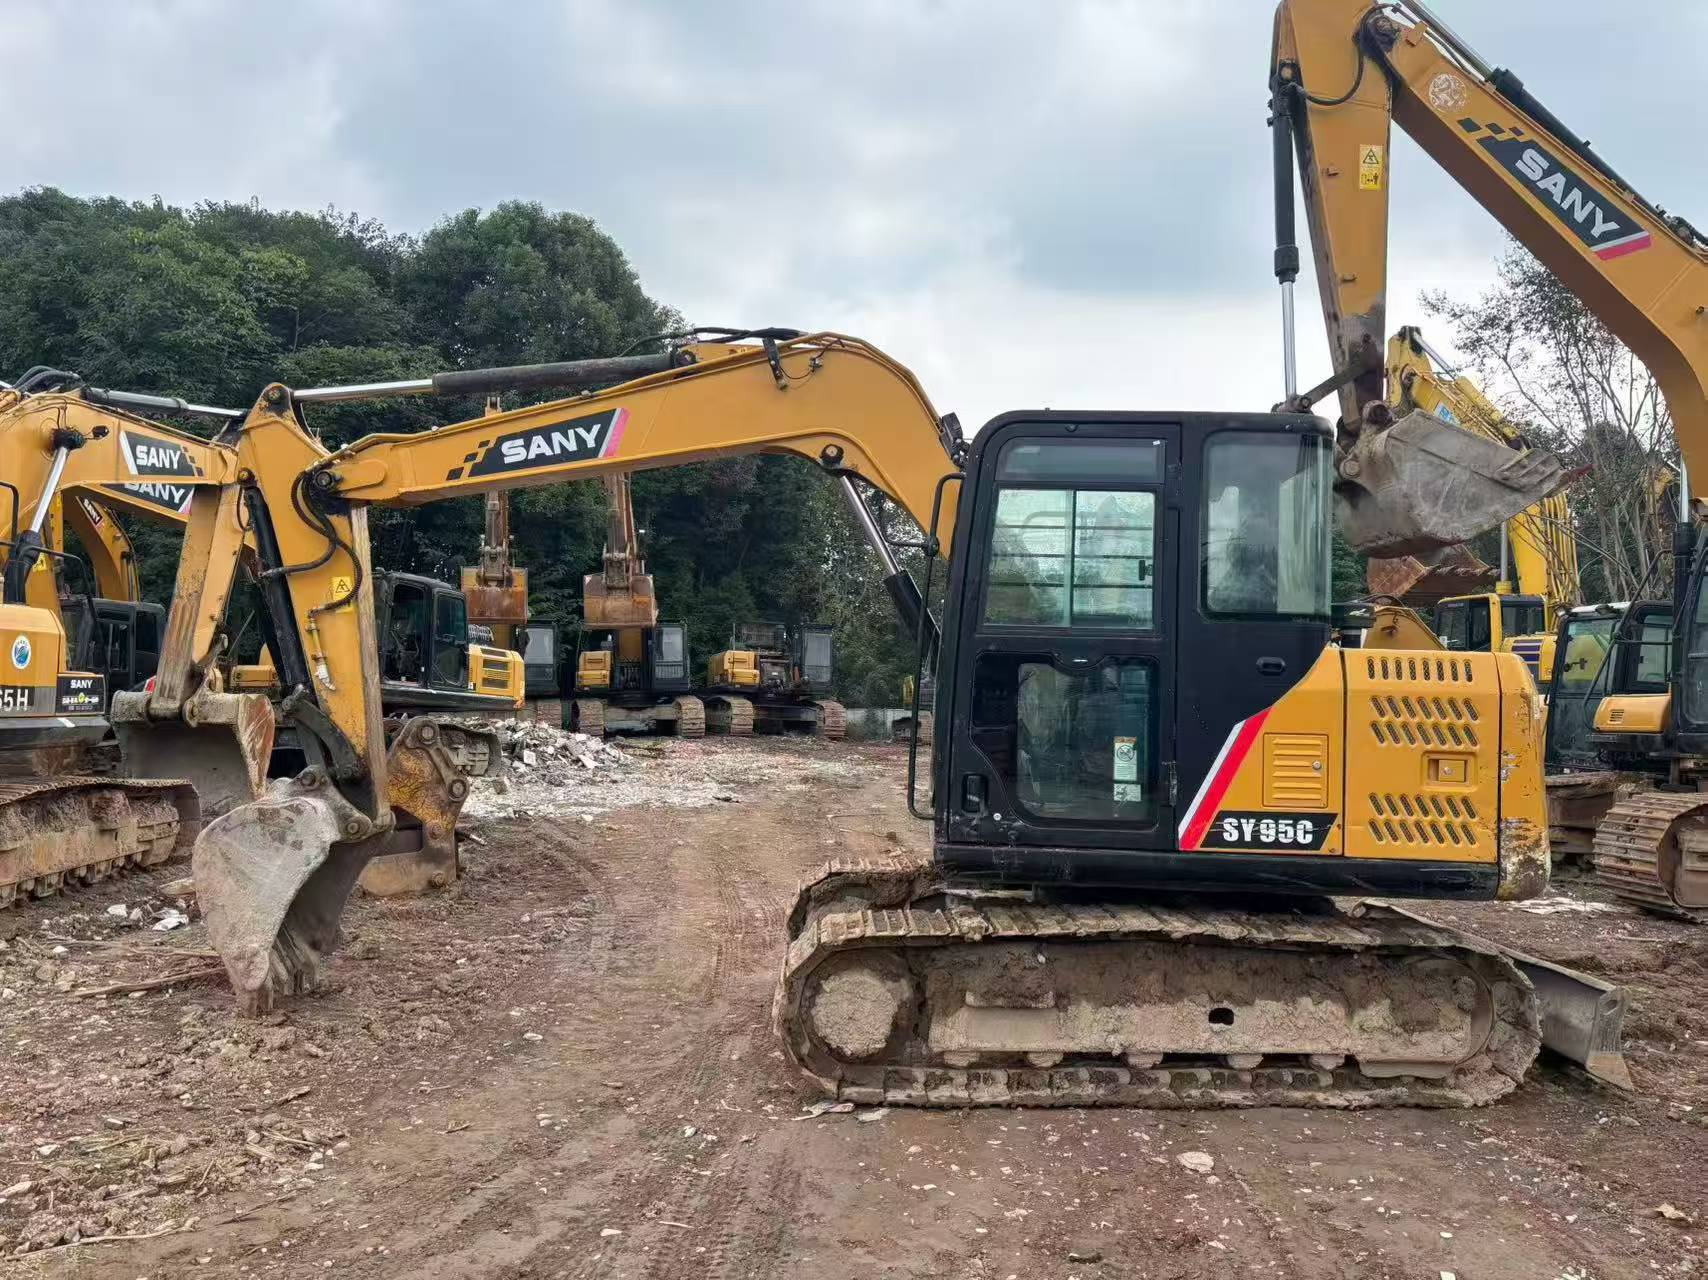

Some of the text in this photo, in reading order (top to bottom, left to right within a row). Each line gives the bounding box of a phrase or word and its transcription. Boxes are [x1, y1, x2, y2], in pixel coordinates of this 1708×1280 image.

[1515, 148, 1620, 238] SANY
[501, 423, 601, 464] SANY
[135, 445, 181, 470] SANY
[70, 679, 93, 689] SANY
[0, 688, 29, 712] 5H
[1222, 817, 1314, 844] SY95C
